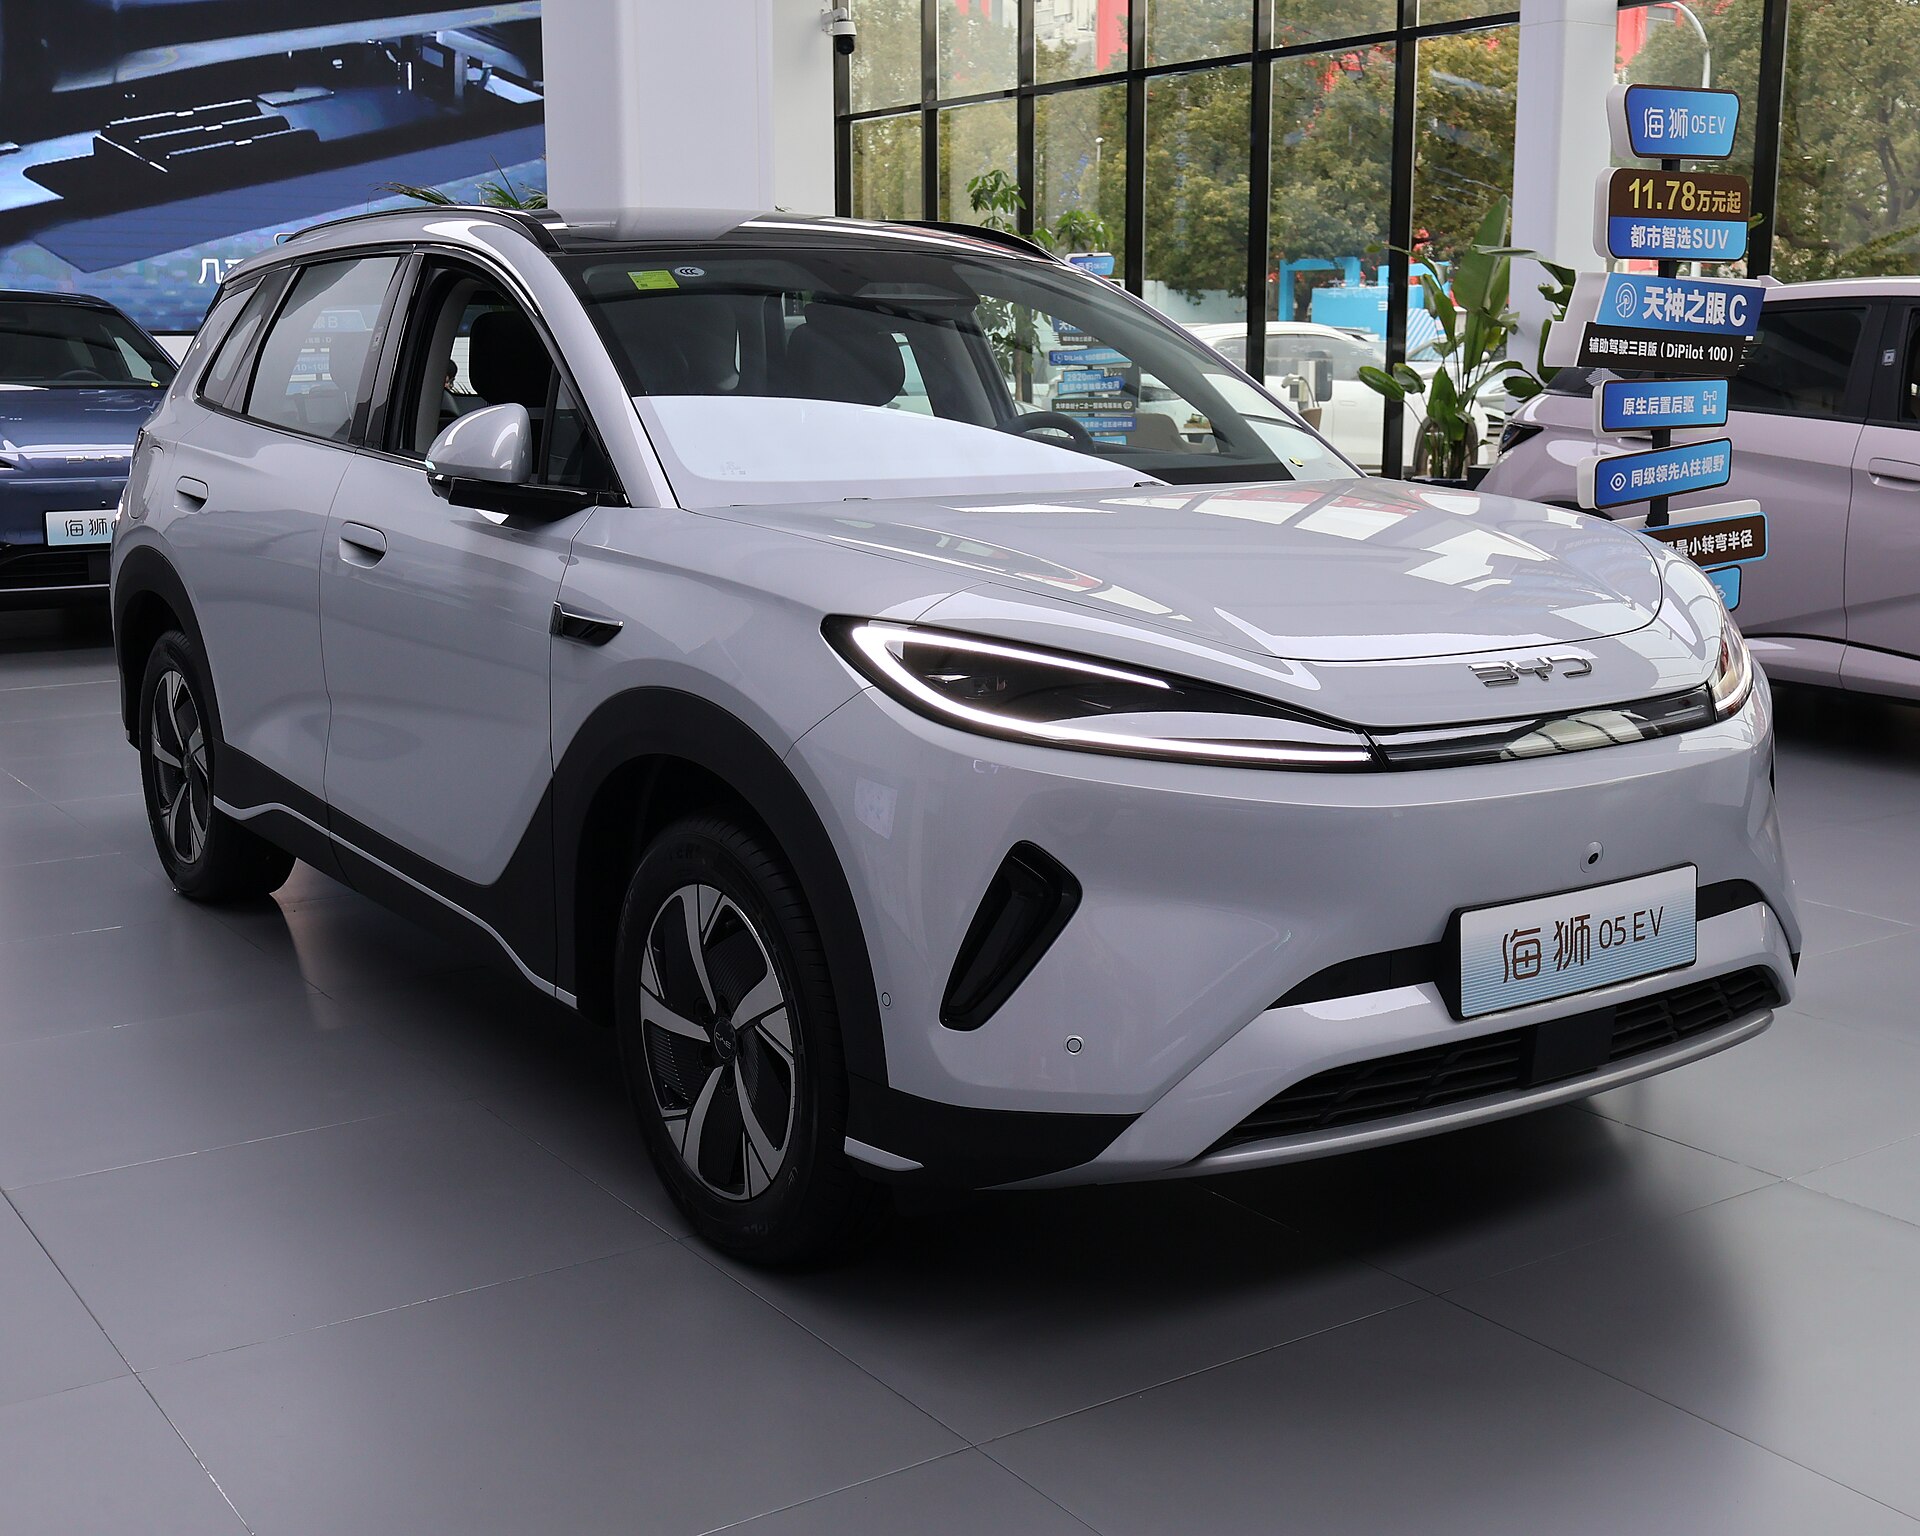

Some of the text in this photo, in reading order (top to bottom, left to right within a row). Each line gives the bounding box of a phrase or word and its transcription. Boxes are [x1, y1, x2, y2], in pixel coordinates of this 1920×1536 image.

[1630, 224, 1730, 250] 都市智选SUV
[1622, 395, 1695, 416] 原生后置后驱
[1631, 454, 1725, 488] 同级领先A柱视野
[1467, 655, 1593, 687] BYD
